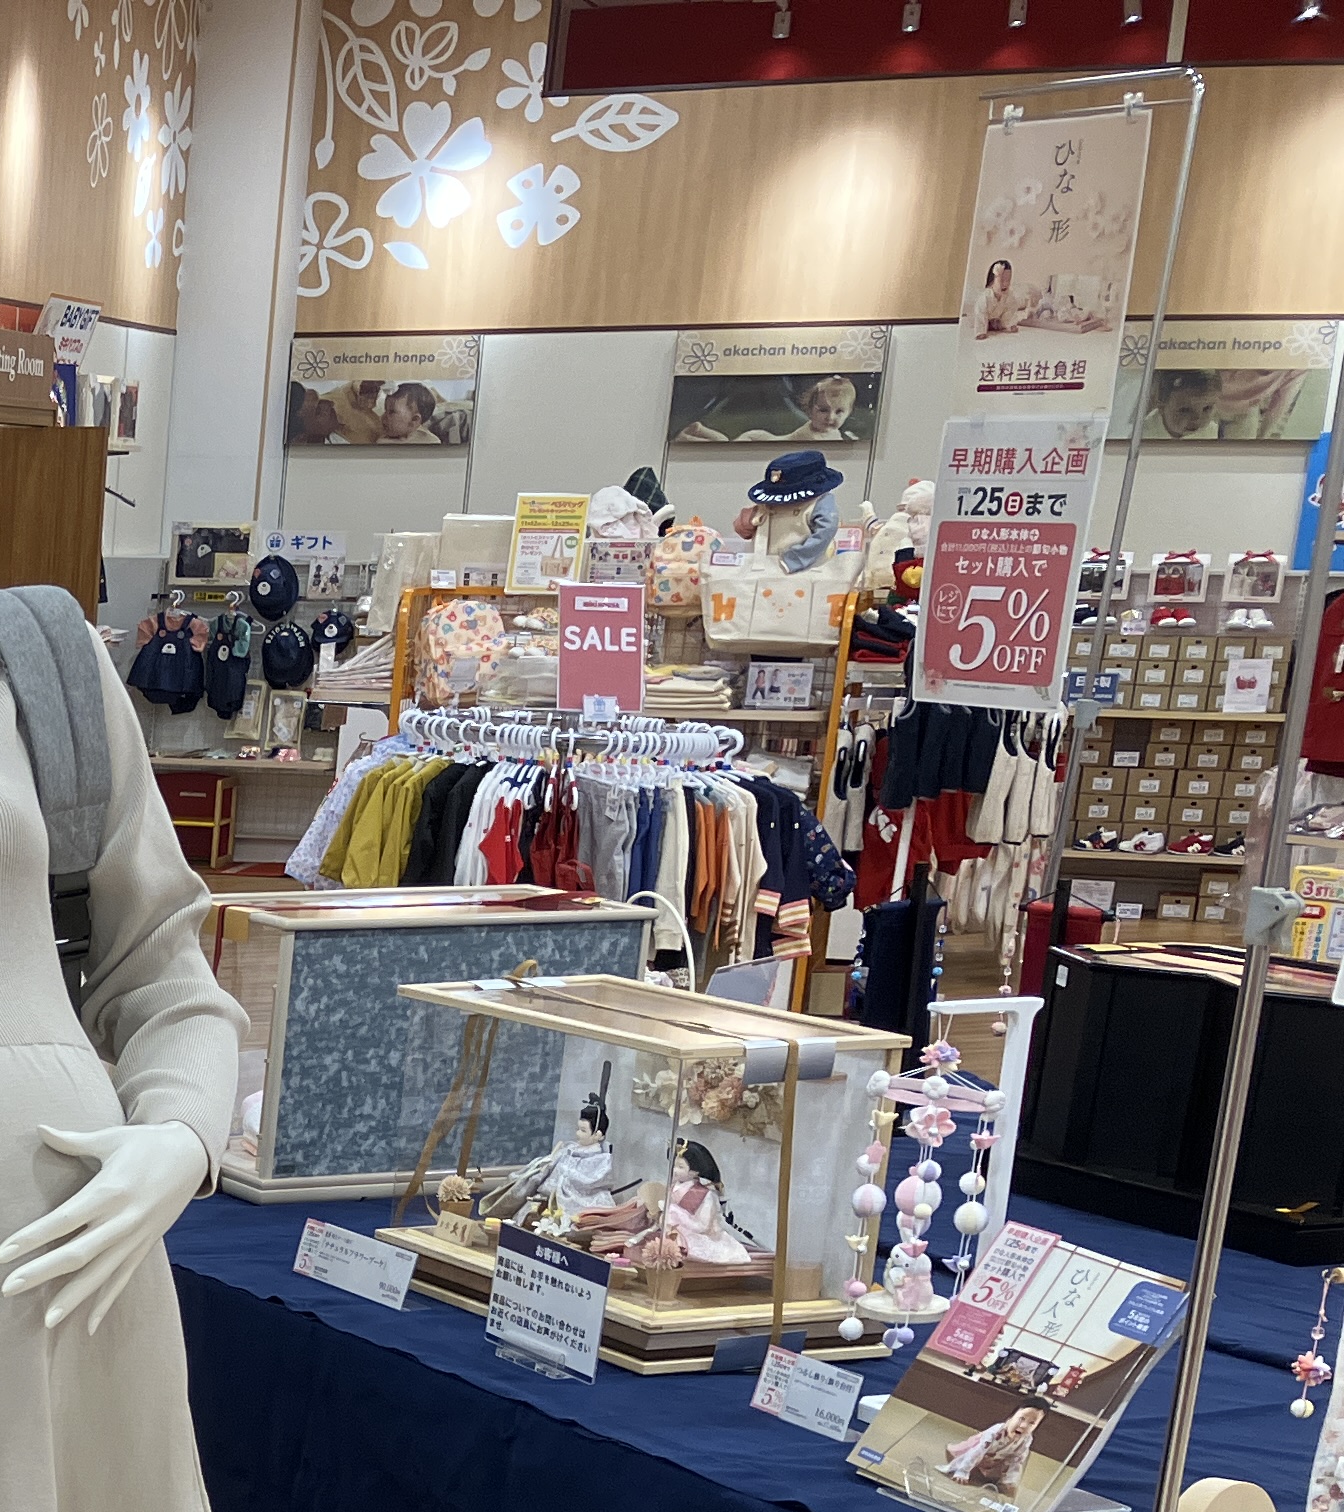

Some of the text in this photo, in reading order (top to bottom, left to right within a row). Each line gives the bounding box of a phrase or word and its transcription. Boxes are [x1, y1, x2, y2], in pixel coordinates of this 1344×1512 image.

[1040, 140, 1076, 243] ひな人形
[723, 342, 838, 358] akachan honpo
[1158, 336, 1283, 354] akachan honpo
[17, 347, 44, 377] Room
[333, 352, 435, 364] akachan honpo
[978, 360, 1087, 382] 送料当社負担
[948, 447, 1090, 475] 早期購入企画
[291, 535, 333, 550] ギフト
[954, 557, 1048, 578] セット購入で
[938, 589, 960, 603] レジ
[936, 605, 958, 618] にて
[563, 626, 638, 651] SALE
[992, 644, 1047, 674] OFF
[535, 1245, 569, 1266] お客様へ
[498, 1256, 592, 1300] 商品には、お手を触れないよう
[1041, 1269, 1089, 1337] ひな人形
[492, 1293, 586, 1339] 商品についてのお問い合わせは
[490, 1306, 592, 1353] お近くの店員にお声がけください
